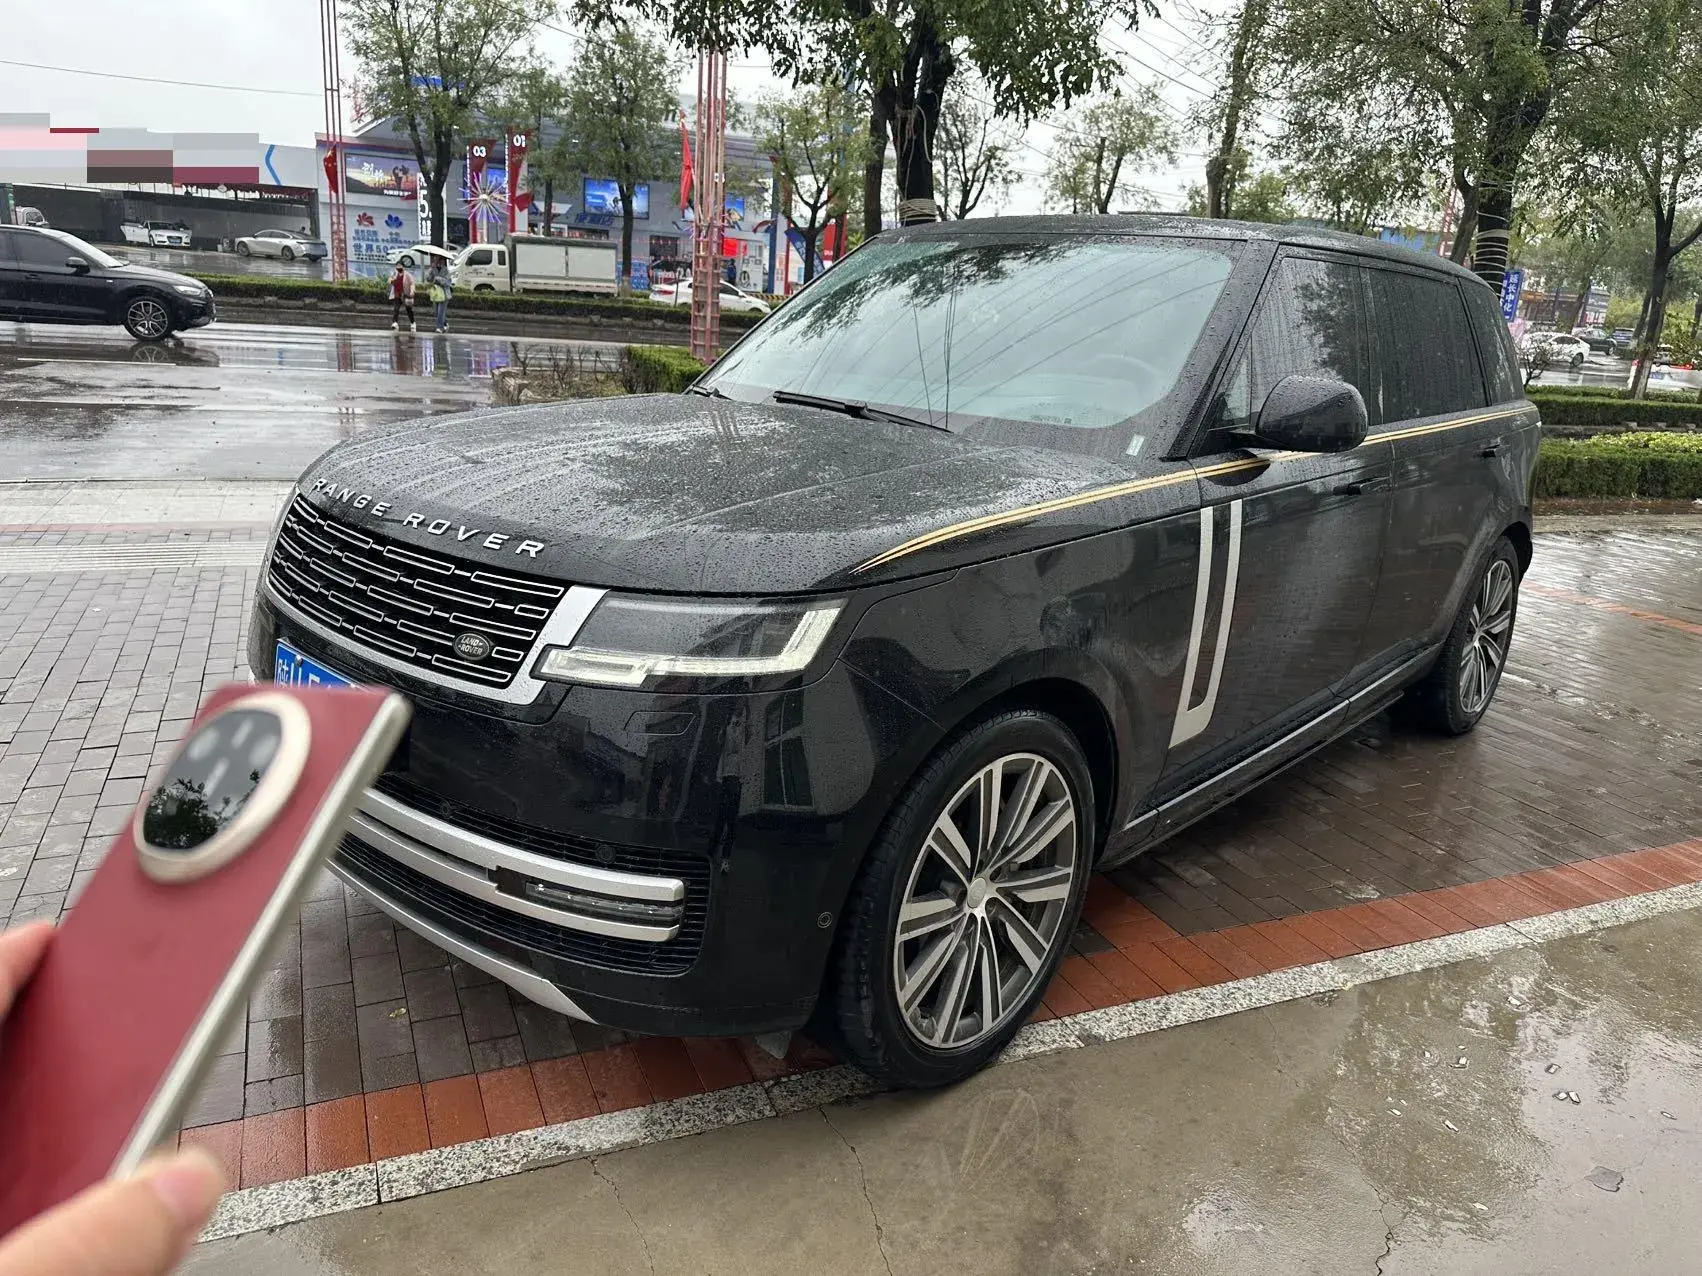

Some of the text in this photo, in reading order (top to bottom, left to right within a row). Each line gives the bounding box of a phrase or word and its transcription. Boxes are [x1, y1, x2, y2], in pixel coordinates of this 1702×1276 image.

[473, 145, 487, 158] 03
[312, 478, 545, 559] RANGE ROVER
[460, 635, 480, 646] LAND
[460, 643, 483, 655] ROVER
